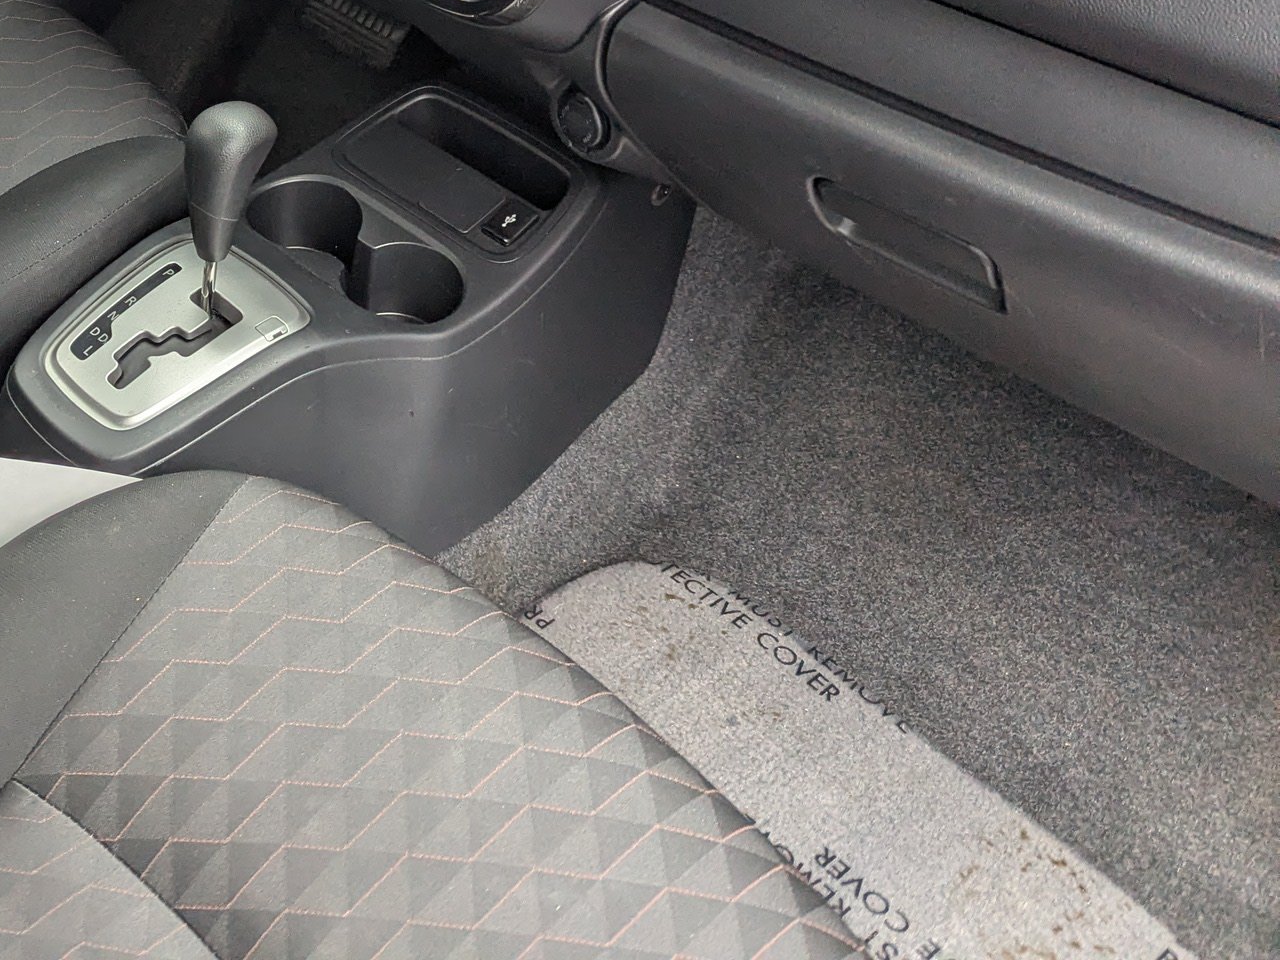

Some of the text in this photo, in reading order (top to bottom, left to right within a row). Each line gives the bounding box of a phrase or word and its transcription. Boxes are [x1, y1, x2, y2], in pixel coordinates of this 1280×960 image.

[162, 268, 175, 276] P
[124, 296, 137, 306] R
[107, 310, 120, 321] N
[89, 326, 101, 336] D
[97, 333, 109, 343] D
[83, 345, 93, 356] L
[646, 559, 840, 702] TECTIVE COVER
[815, 846, 909, 933] COVER
